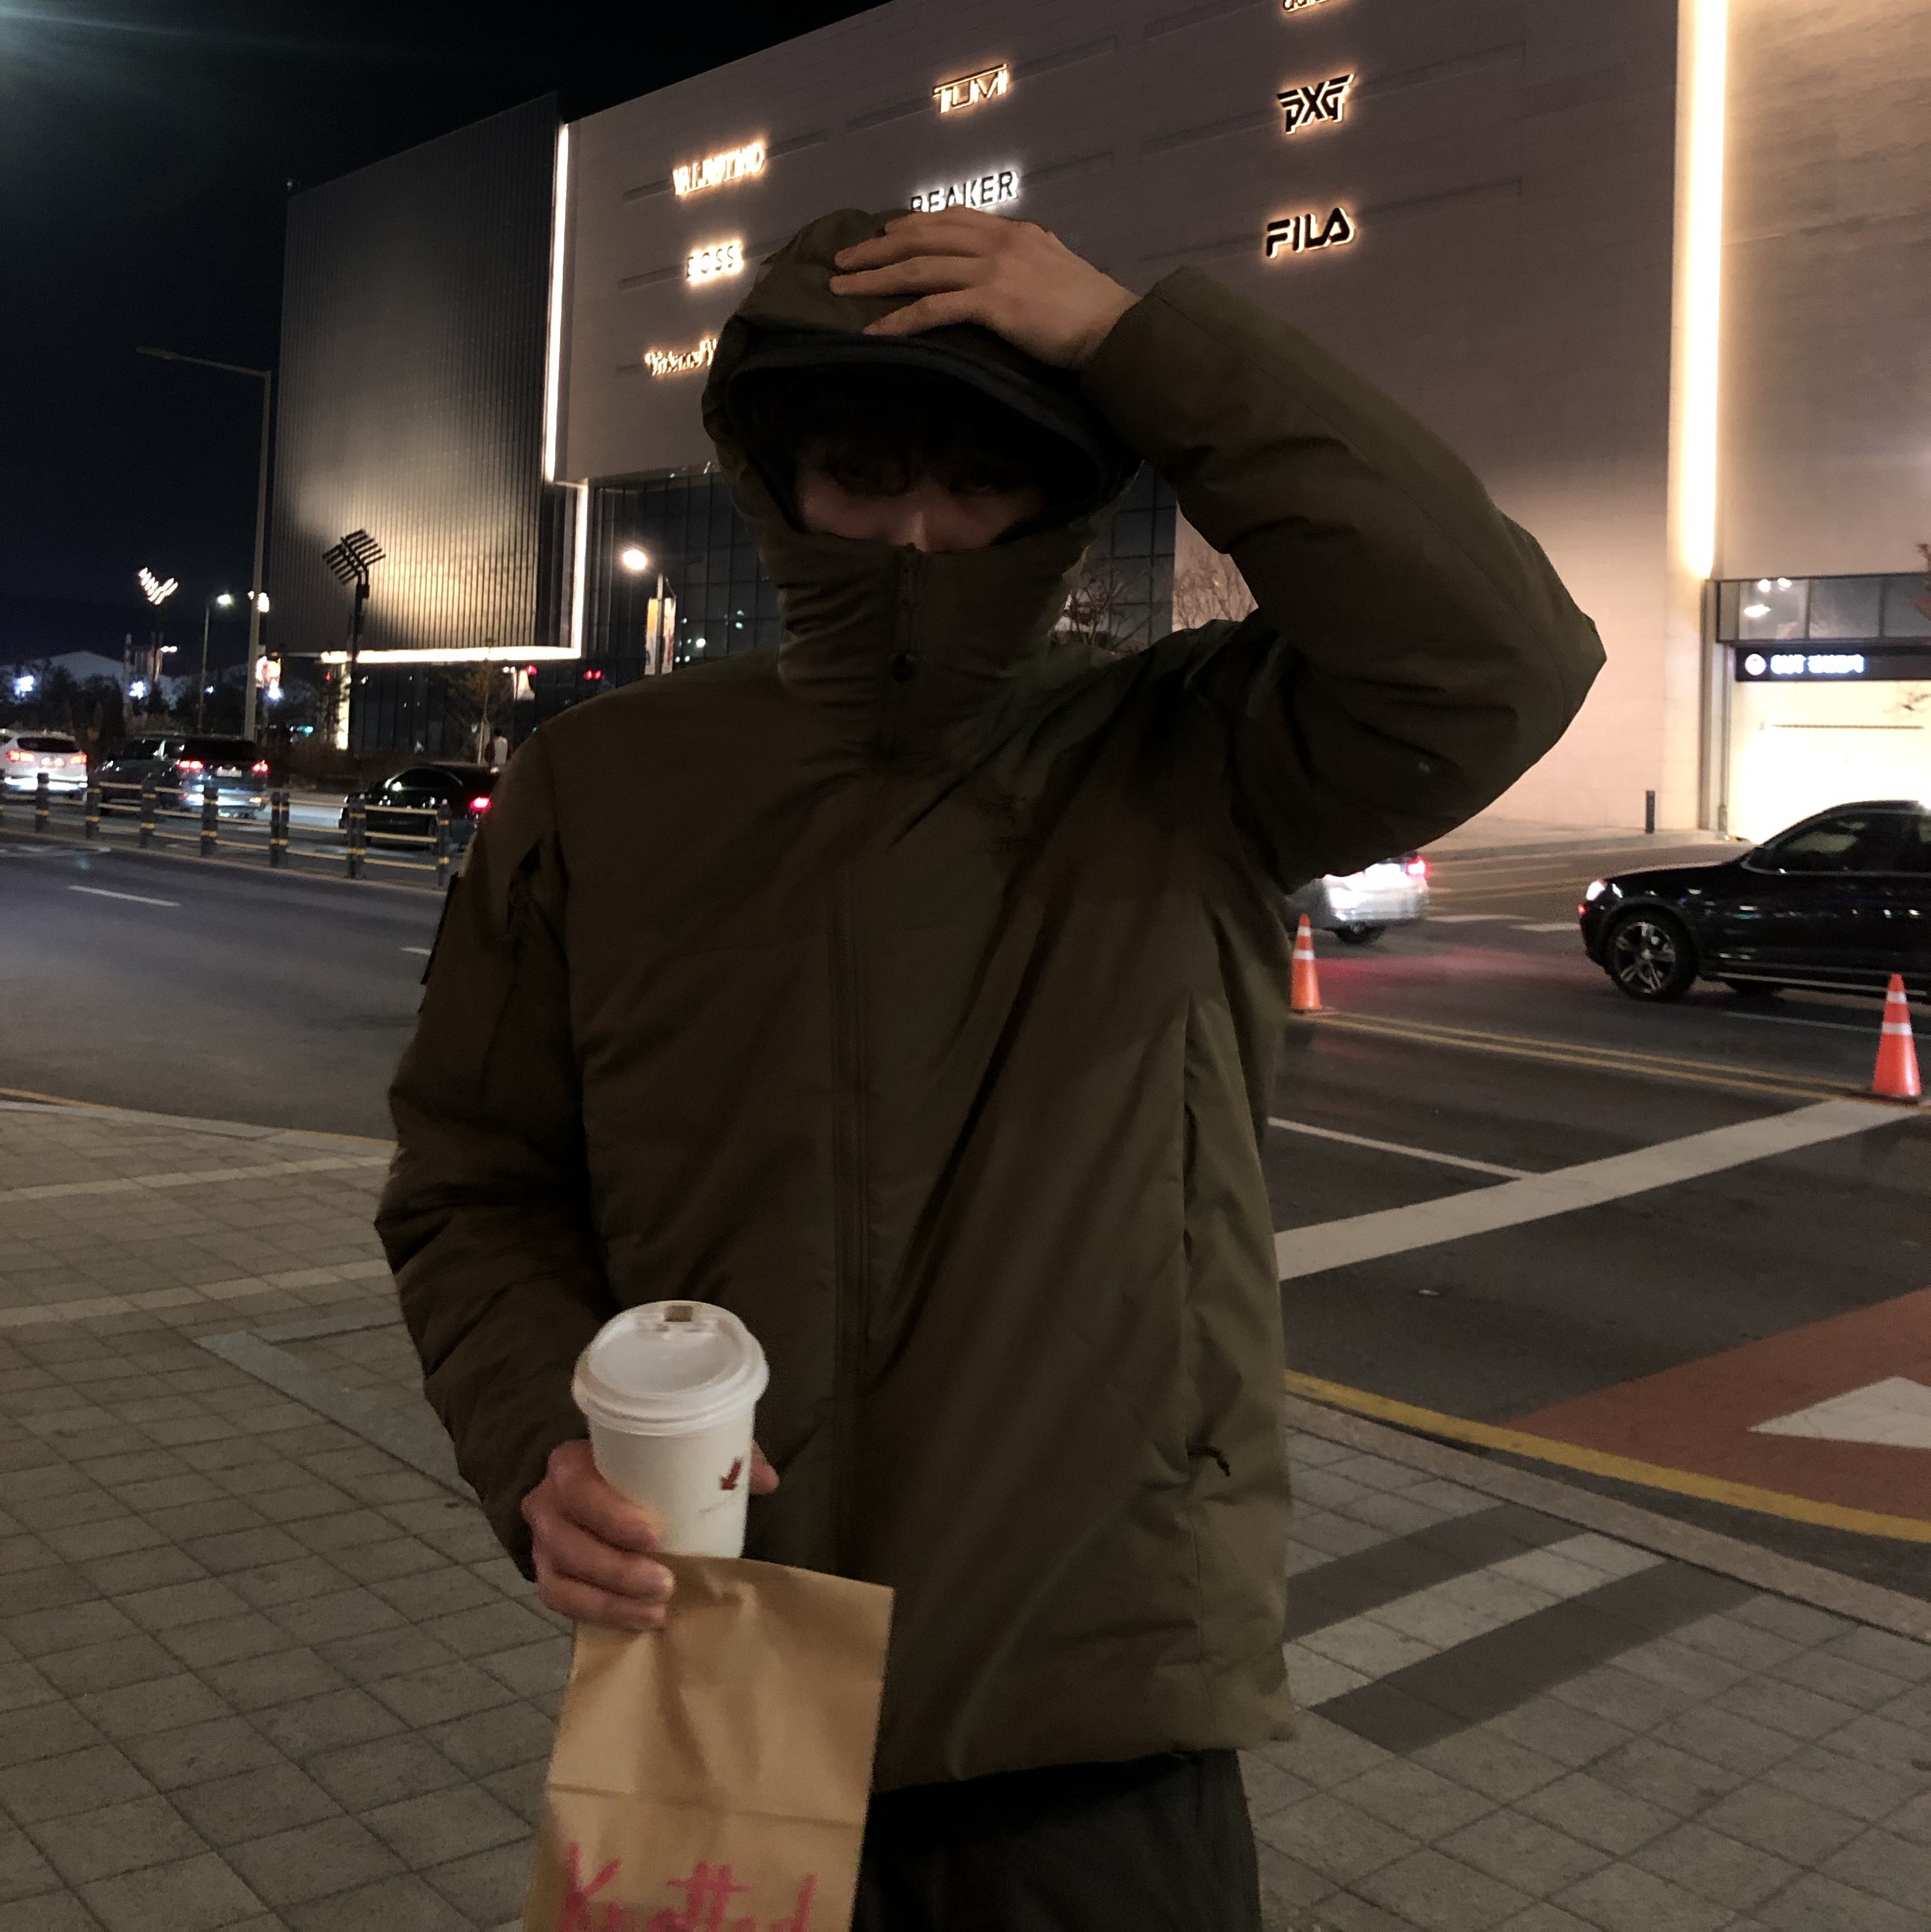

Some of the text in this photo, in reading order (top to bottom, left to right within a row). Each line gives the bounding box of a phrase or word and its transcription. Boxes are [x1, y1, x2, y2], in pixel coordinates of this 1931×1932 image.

[933, 63, 1008, 114] TUMI
[1277, 73, 1355, 135] PXG
[910, 170, 1019, 213] BEAKER
[1265, 206, 1355, 259] FILA
[685, 243, 739, 282] BOSS
